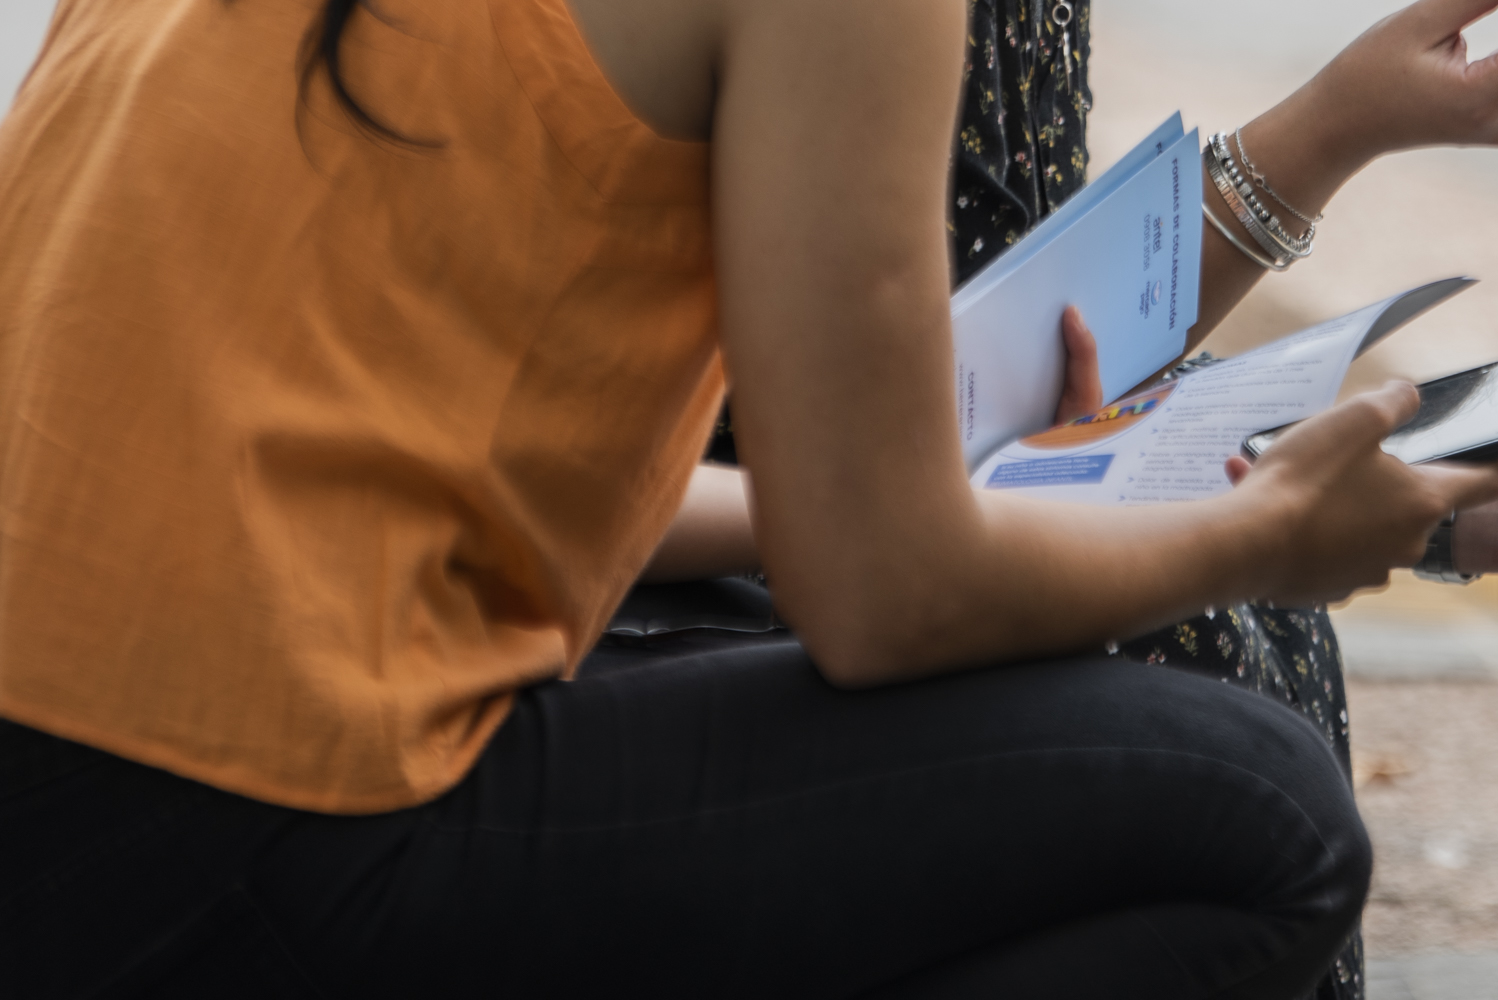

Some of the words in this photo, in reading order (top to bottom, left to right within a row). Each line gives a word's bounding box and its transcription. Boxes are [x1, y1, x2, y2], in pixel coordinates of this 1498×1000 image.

[1172, 157, 1180, 213] FORMAS
[1153, 216, 1163, 255] antel
[1173, 214, 1180, 232] DE
[1169, 234, 1179, 331] COLABORACIÓN
[967, 371, 975, 441] CONTACTO
